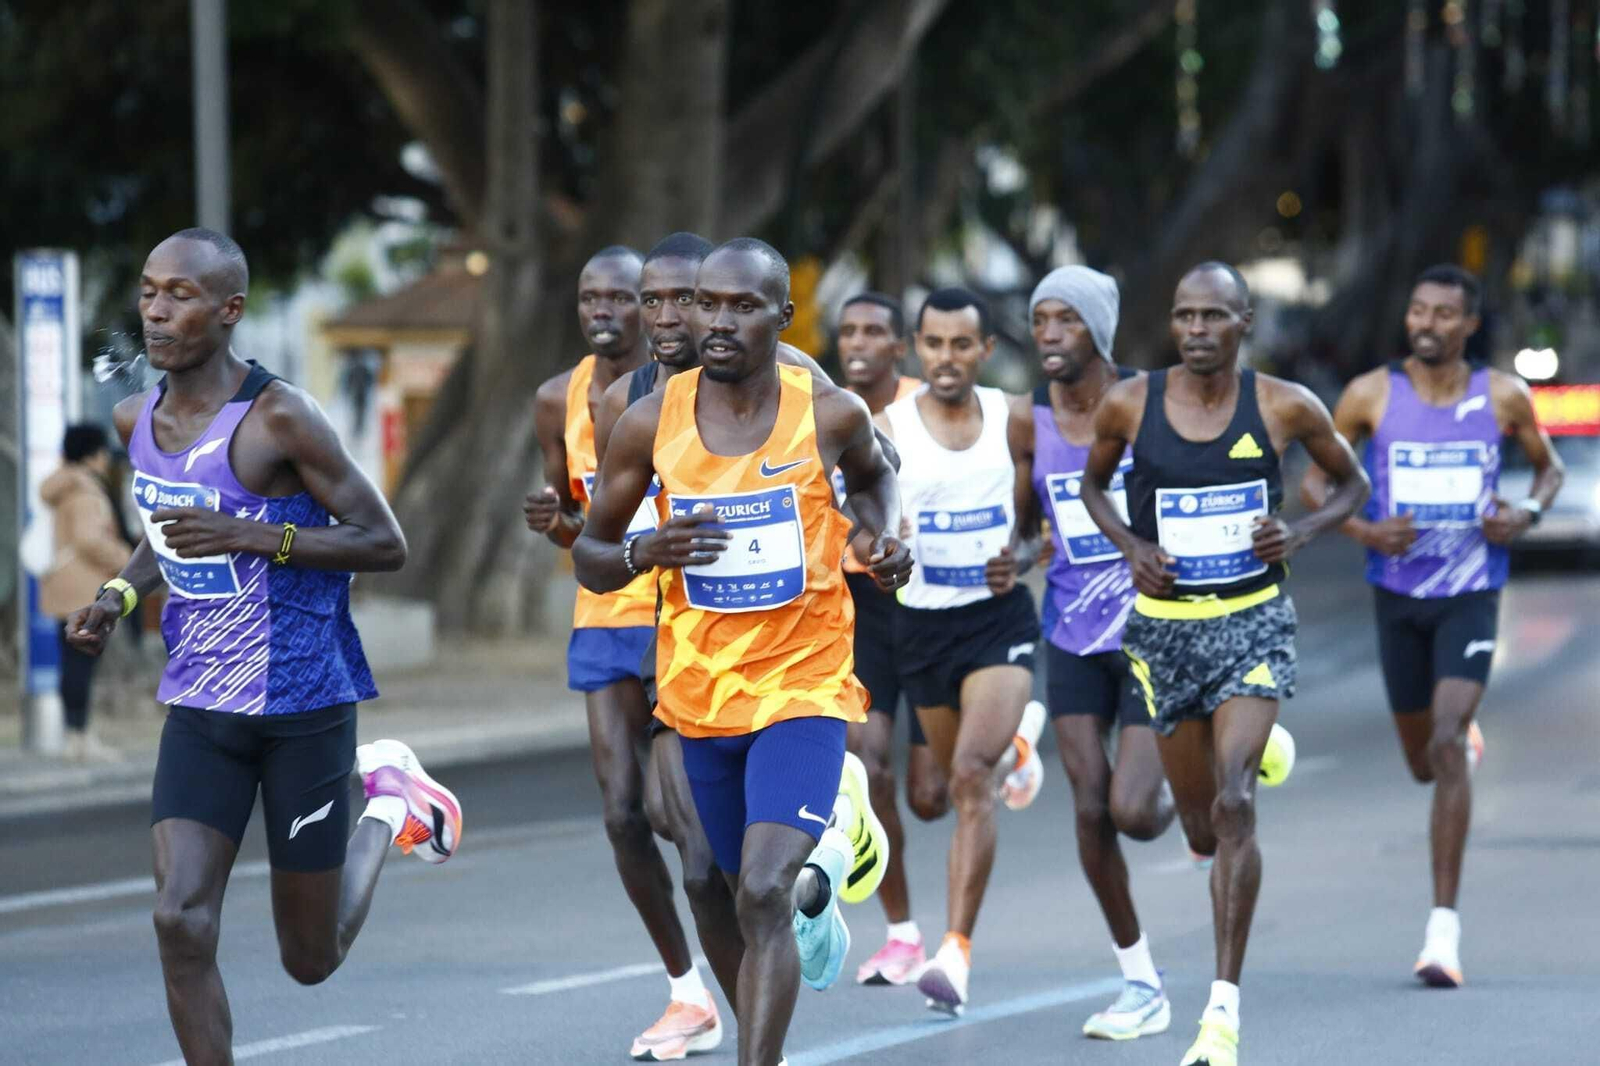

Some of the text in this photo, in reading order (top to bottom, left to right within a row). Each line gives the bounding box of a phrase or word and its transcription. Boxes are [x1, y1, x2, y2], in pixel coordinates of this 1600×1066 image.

[157, 491, 196, 507] ZURICH
[715, 500, 771, 518] ZURICH
[1222, 524, 1240, 537] 12
[748, 539, 761, 554] 4
